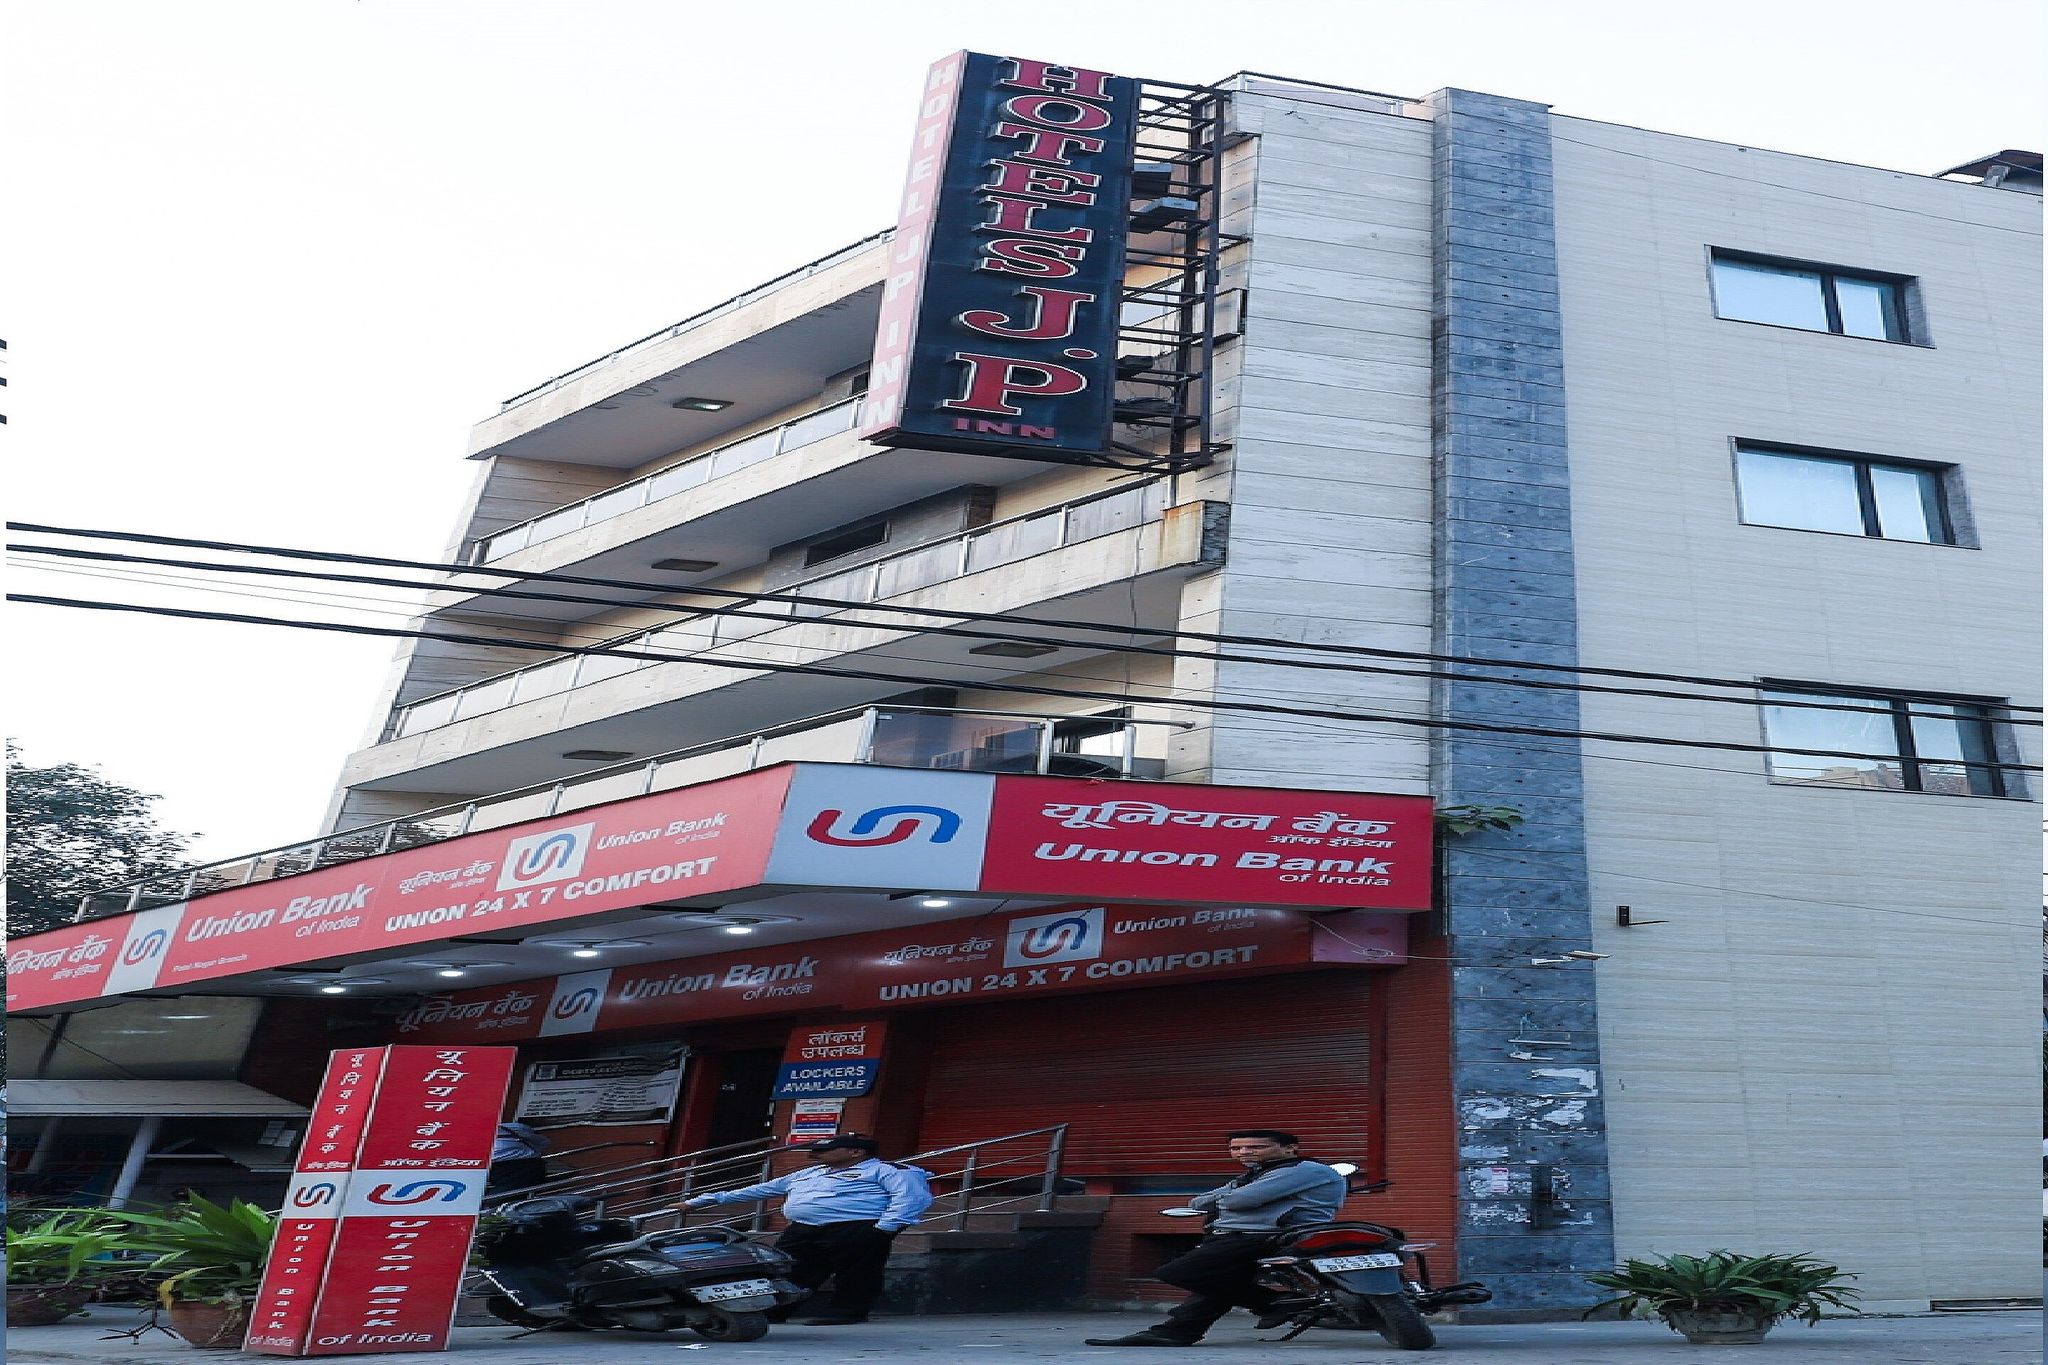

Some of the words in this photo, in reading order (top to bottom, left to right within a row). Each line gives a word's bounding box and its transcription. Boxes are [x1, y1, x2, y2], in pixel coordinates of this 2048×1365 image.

[905, 62, 957, 215] HOTEL
[978, 56, 1117, 278] HOTELS
[955, 417, 1056, 440] INN
[596, 826, 662, 850] Union
[664, 811, 731, 836] Bank
[1040, 799, 1281, 830] यूनियन
[1291, 811, 1397, 836] बैंक
[399, 869, 465, 896] यूनियन
[462, 858, 497, 880] बैंक
[1033, 842, 1220, 868] Union
[1235, 851, 1397, 875] Bank
[384, 903, 469, 933] UNION
[470, 895, 505, 917] 24
[509, 890, 534, 911] X
[539, 886, 558, 905] 7
[562, 856, 719, 900] COMFORT
[1318, 874, 1392, 887] India
[186, 908, 279, 943] Union
[279, 882, 376, 925] Bank
[318, 913, 362, 937] India
[1113, 914, 1187, 936] Union
[1191, 908, 1258, 926] Bank
[617, 971, 715, 1001] Union
[721, 955, 820, 989] Bank
[879, 976, 971, 1001] UNION
[980, 972, 1018, 992] 24
[1026, 969, 1050, 986] X
[1057, 967, 1076, 982] 7
[1086, 944, 1260, 980] COMFORT
[780, 1079, 867, 1093] AVAILABLE
[790, 1065, 867, 1080] LOCKERS
[376, 1220, 431, 1272] Union
[363, 1285, 410, 1327] Bank
[357, 1331, 434, 1344] India
